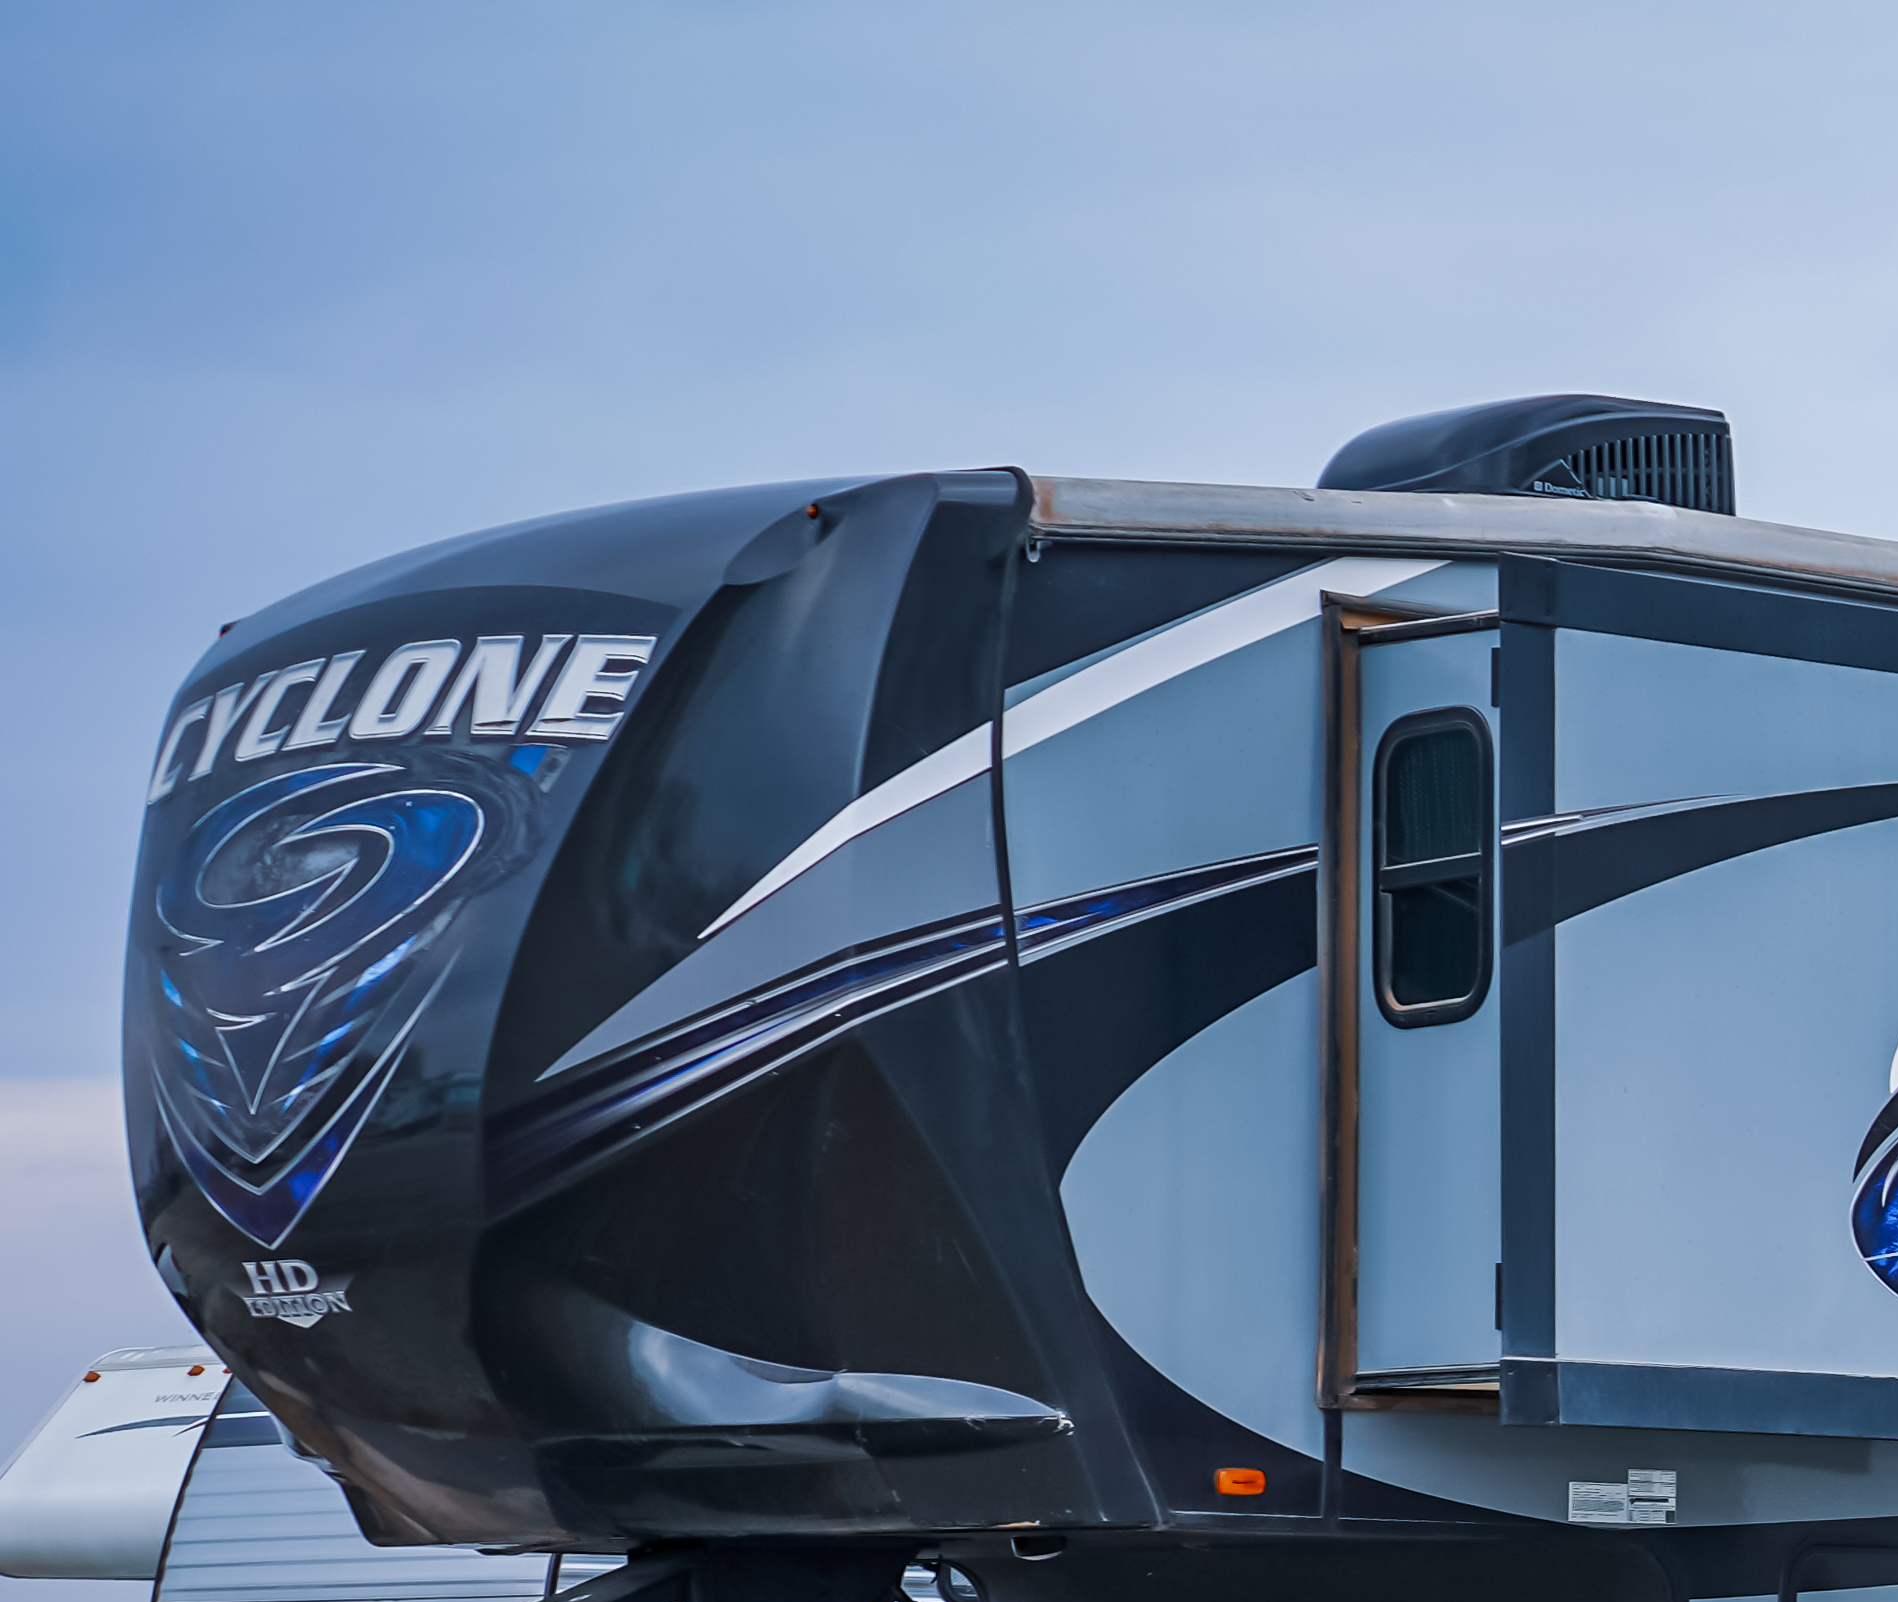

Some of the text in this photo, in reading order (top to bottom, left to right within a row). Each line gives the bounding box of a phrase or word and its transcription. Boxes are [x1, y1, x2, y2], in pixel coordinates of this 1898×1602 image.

[146, 634, 658, 806] CYCLONE
[241, 1258, 320, 1295] HD
[242, 1289, 354, 1319] EDITION
